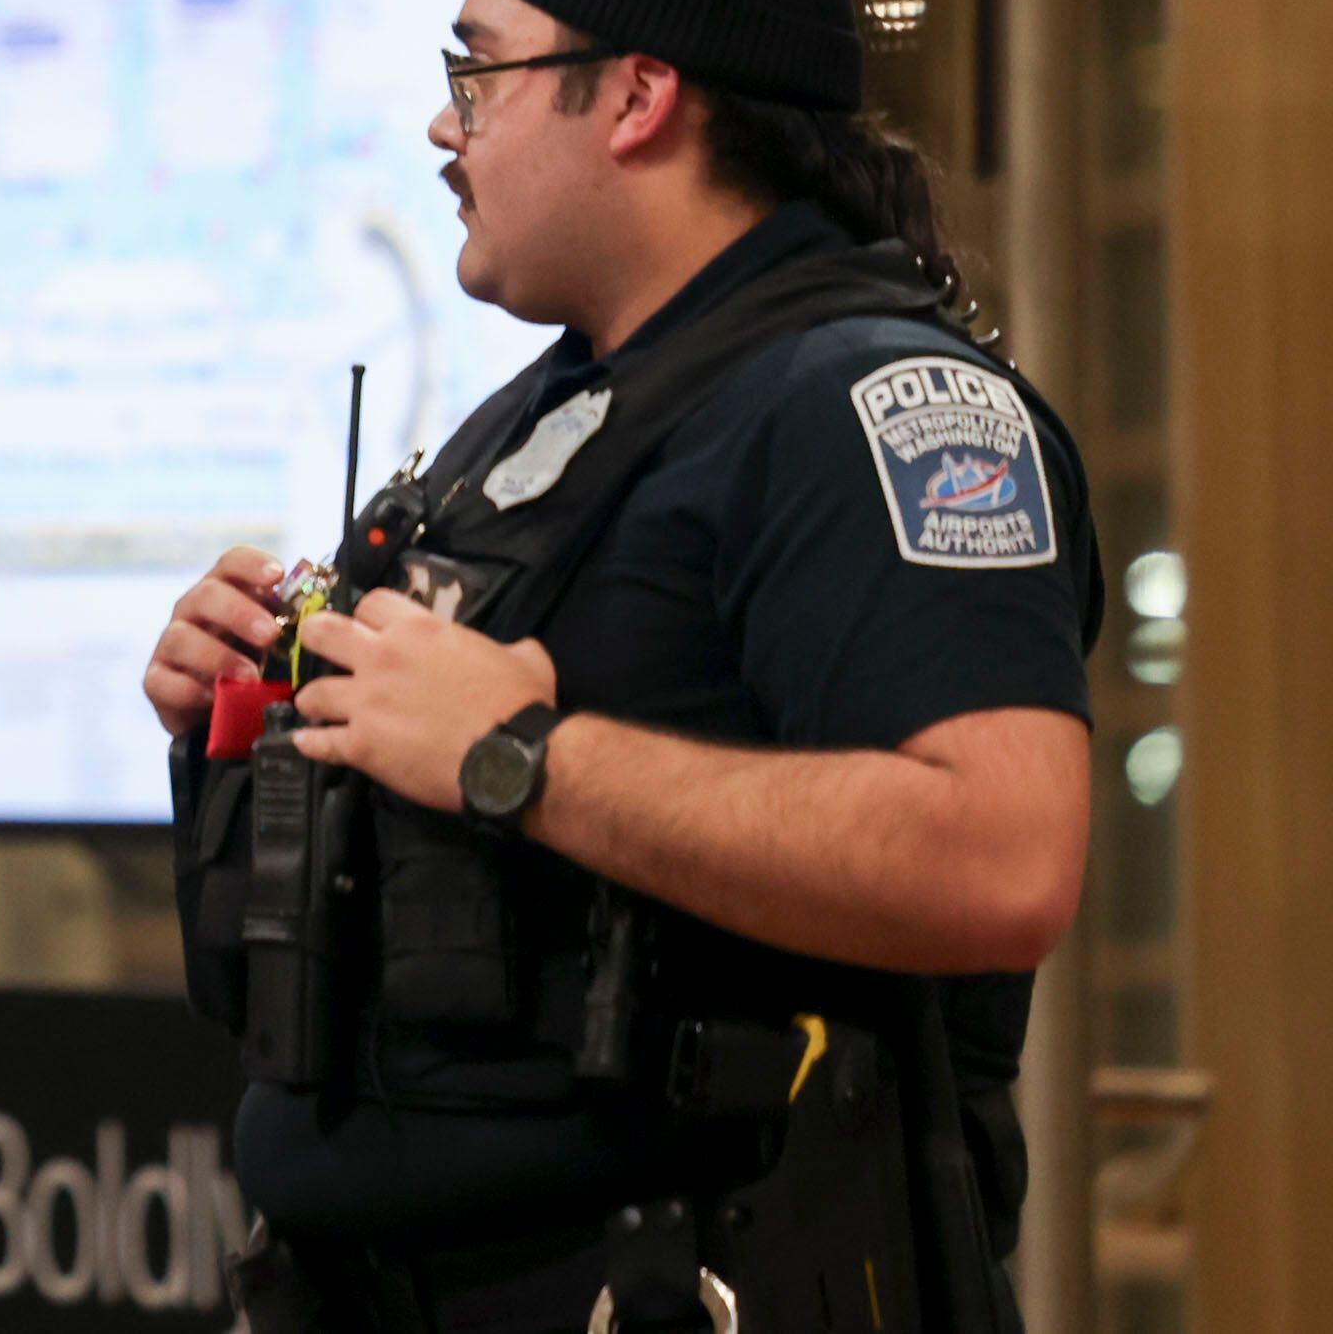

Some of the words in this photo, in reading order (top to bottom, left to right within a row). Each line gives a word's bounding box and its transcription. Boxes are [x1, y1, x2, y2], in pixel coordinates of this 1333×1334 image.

[864, 367, 1022, 425] POLICE
[881, 411, 1023, 447] METROPOLITAN
[894, 424, 1022, 463] WASHINGTON
[923, 509, 1033, 536] AIRPORTS
[918, 530, 1036, 554] AUTHORITY
